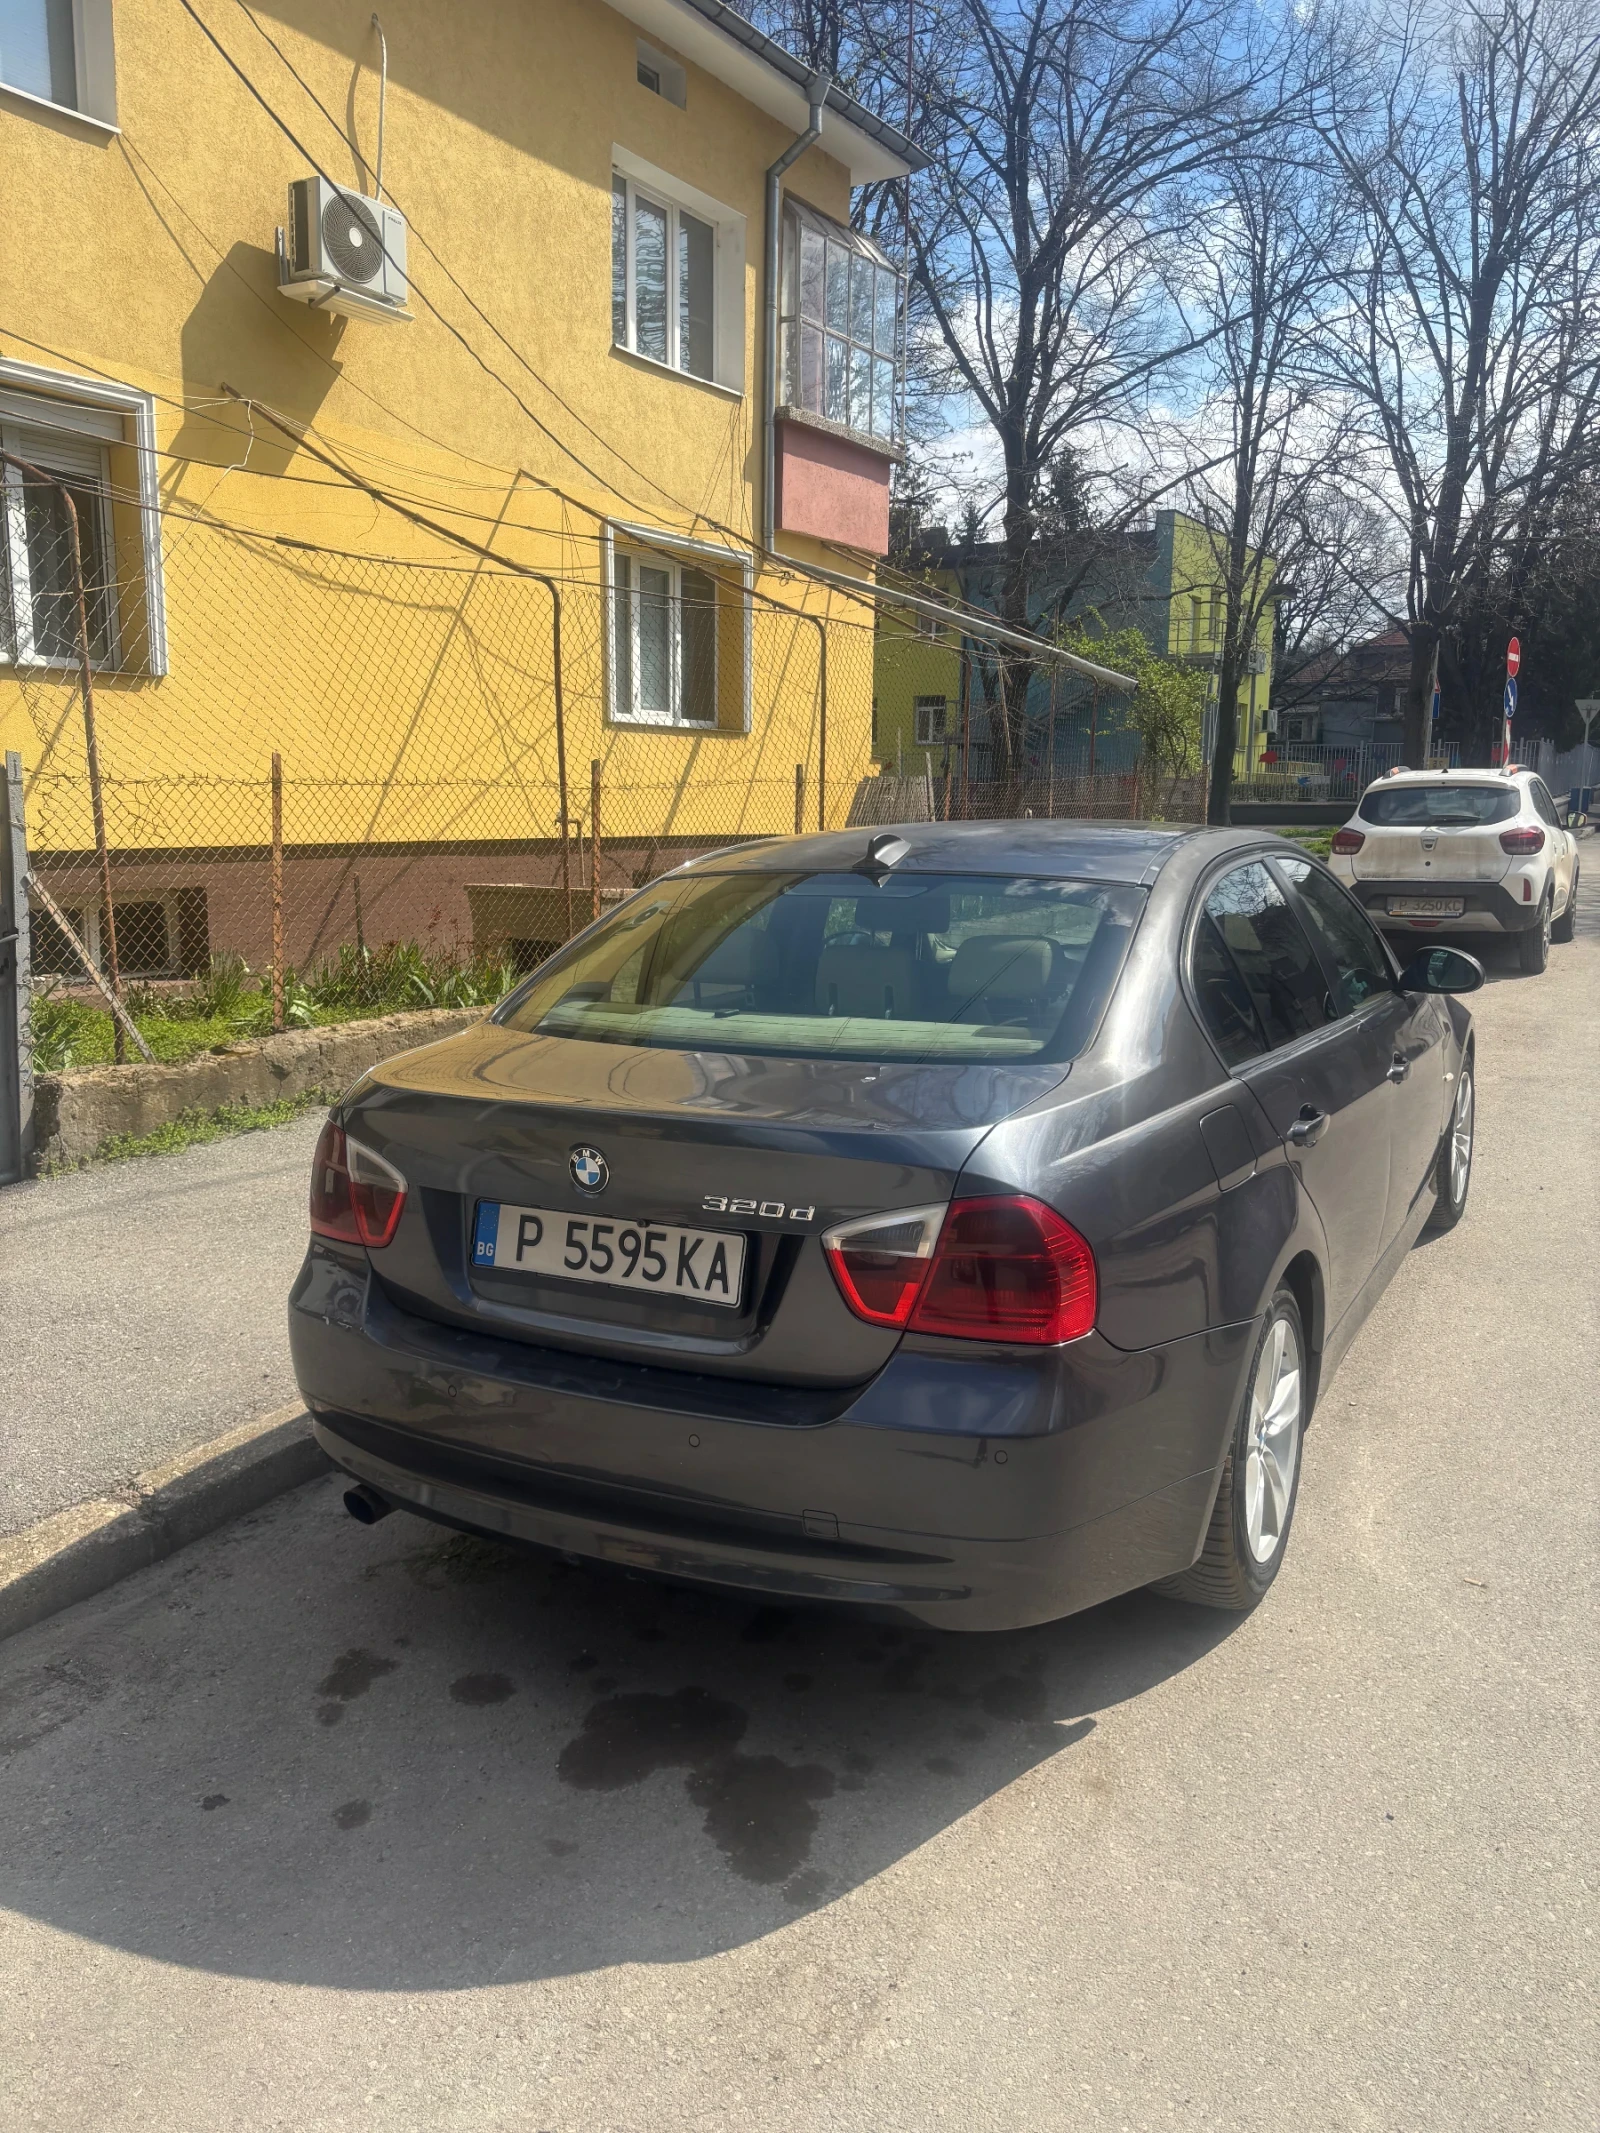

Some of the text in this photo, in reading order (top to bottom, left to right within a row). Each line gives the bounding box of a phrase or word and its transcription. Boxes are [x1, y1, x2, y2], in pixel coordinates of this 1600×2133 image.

[571, 1150, 604, 1165] BMW
[702, 1194, 816, 1221] 320d
[516, 1213, 543, 1262] P
[476, 1241, 494, 1257] BG
